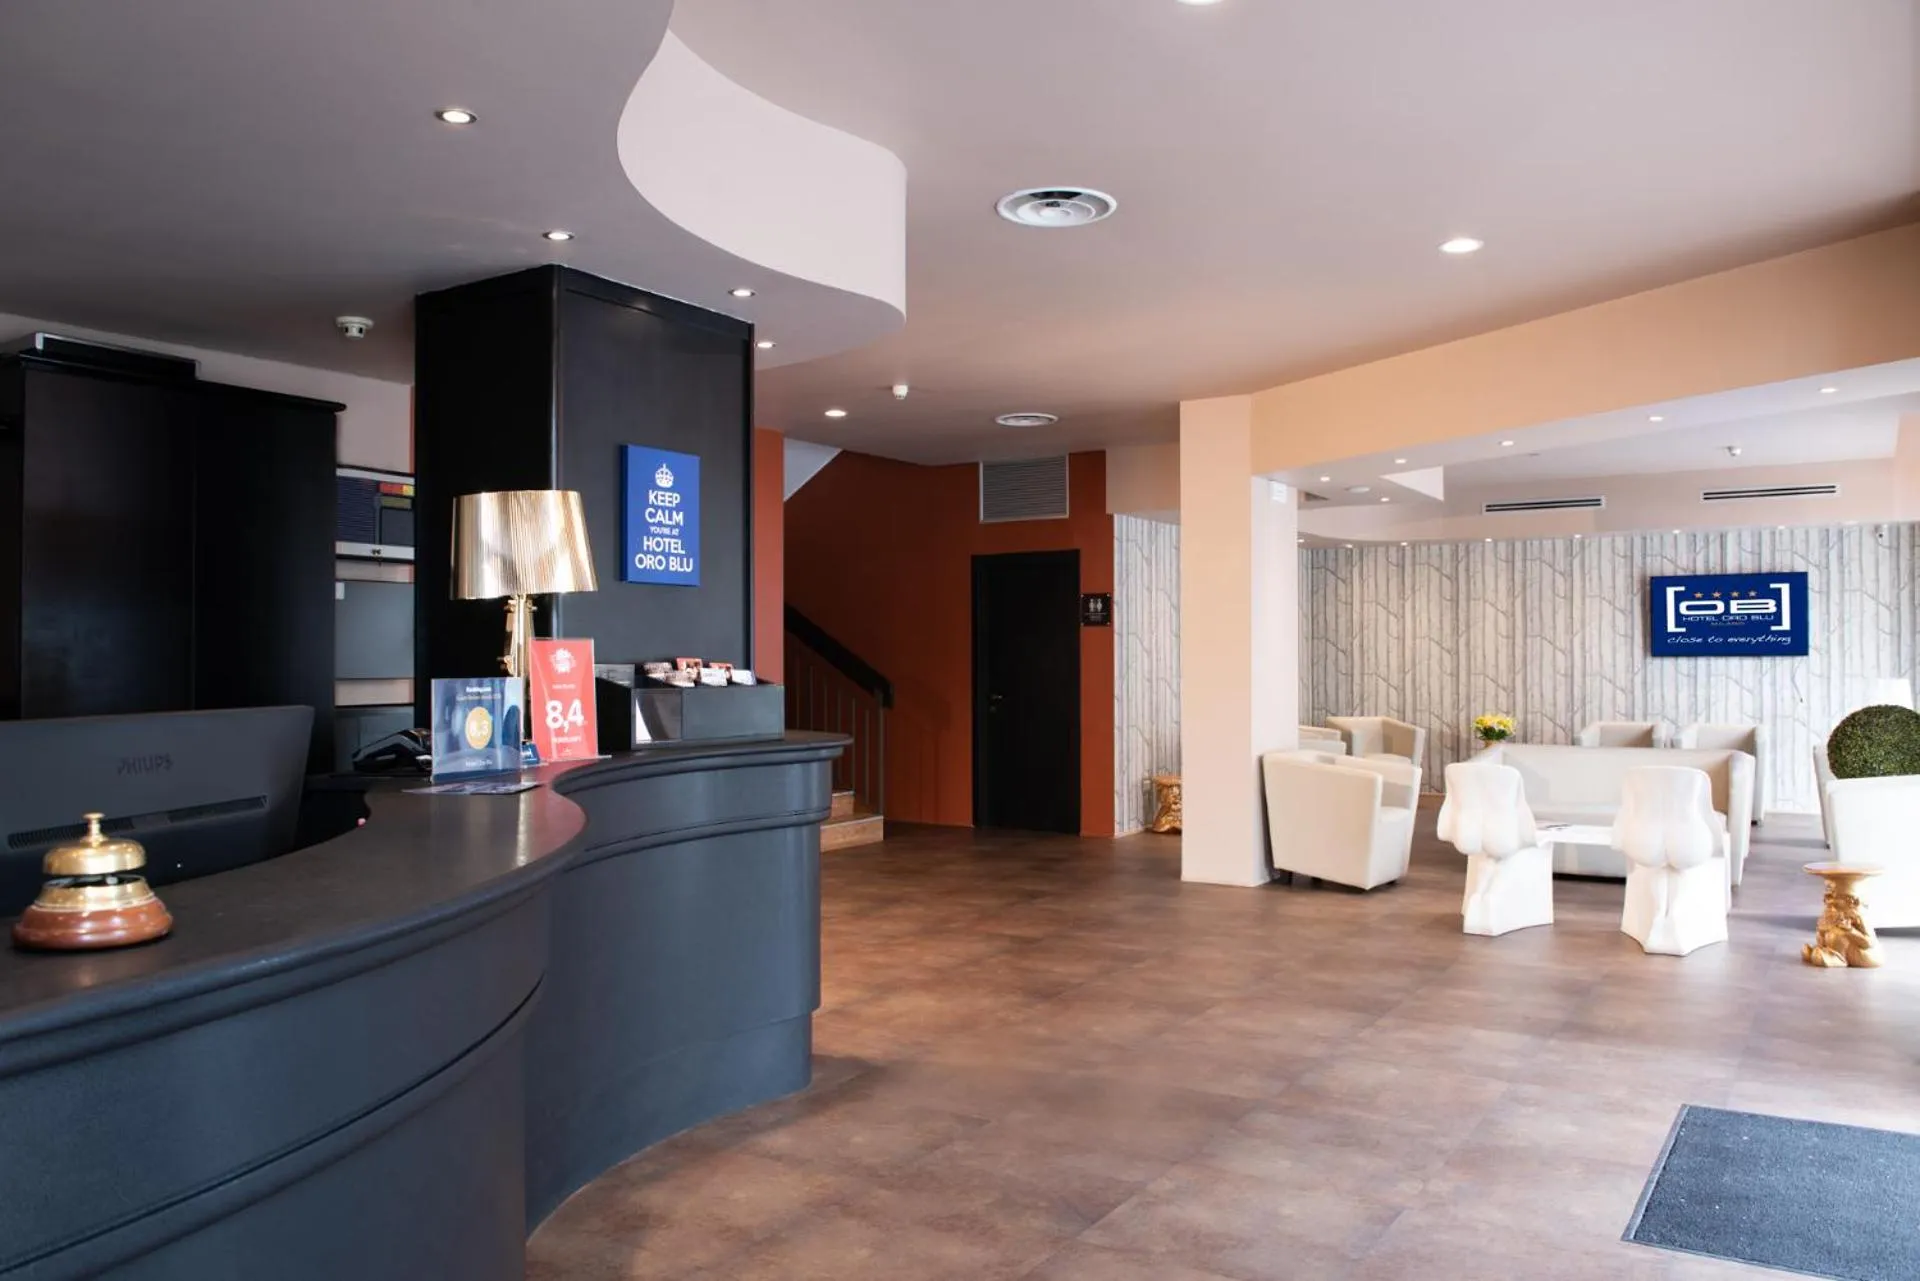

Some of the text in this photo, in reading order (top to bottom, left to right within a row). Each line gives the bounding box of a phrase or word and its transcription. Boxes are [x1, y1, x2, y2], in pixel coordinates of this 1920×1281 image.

[649, 490, 680, 507] KEEP
[645, 508, 683, 526] CALM
[643, 536, 685, 554] HOTEL
[635, 554, 693, 572] ORO BLU
[1667, 634, 1791, 645] close to everything
[545, 699, 584, 734] 8,4
